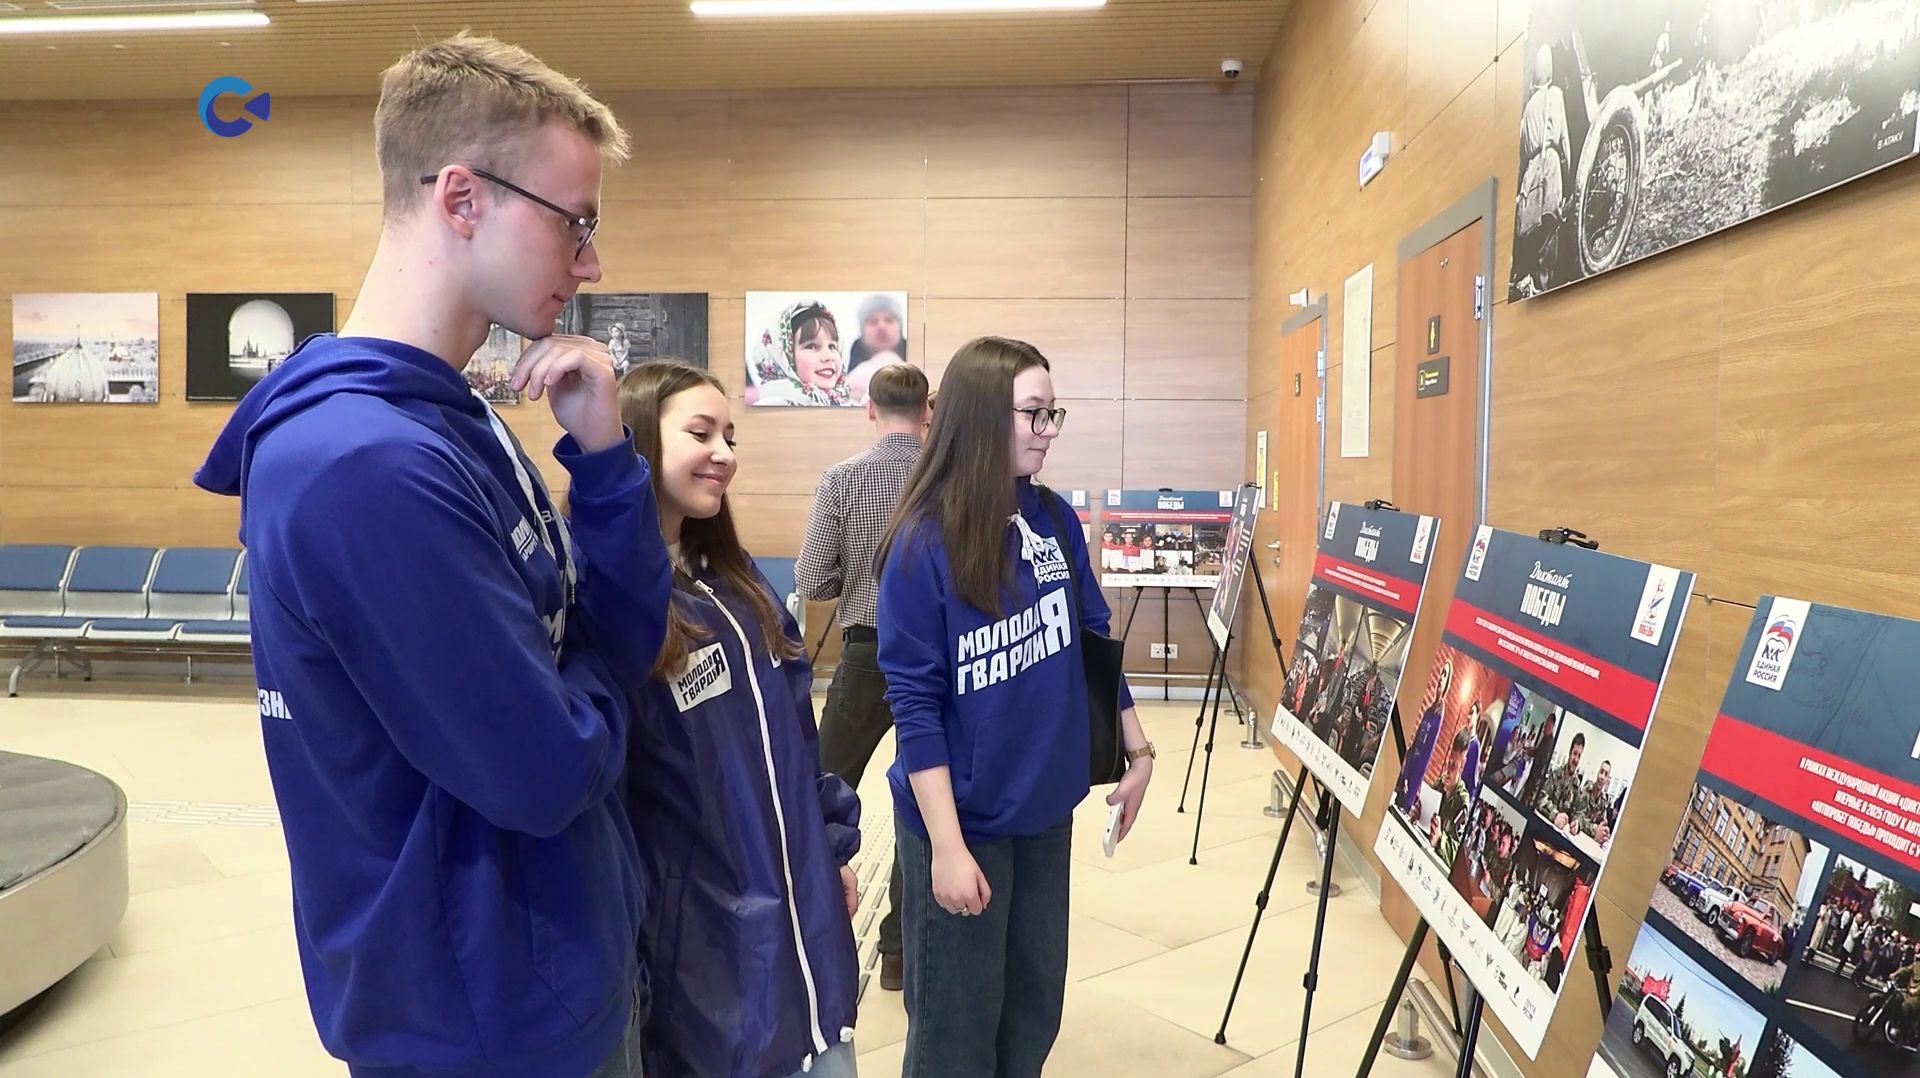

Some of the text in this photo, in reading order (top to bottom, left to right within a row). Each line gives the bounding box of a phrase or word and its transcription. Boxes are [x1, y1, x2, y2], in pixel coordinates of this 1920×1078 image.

[1883, 131, 1904, 147] АТАКУ
[1520, 583, 1567, 627] ПОБЕДЫ
[1753, 669, 1778, 682] РОССИЯ
